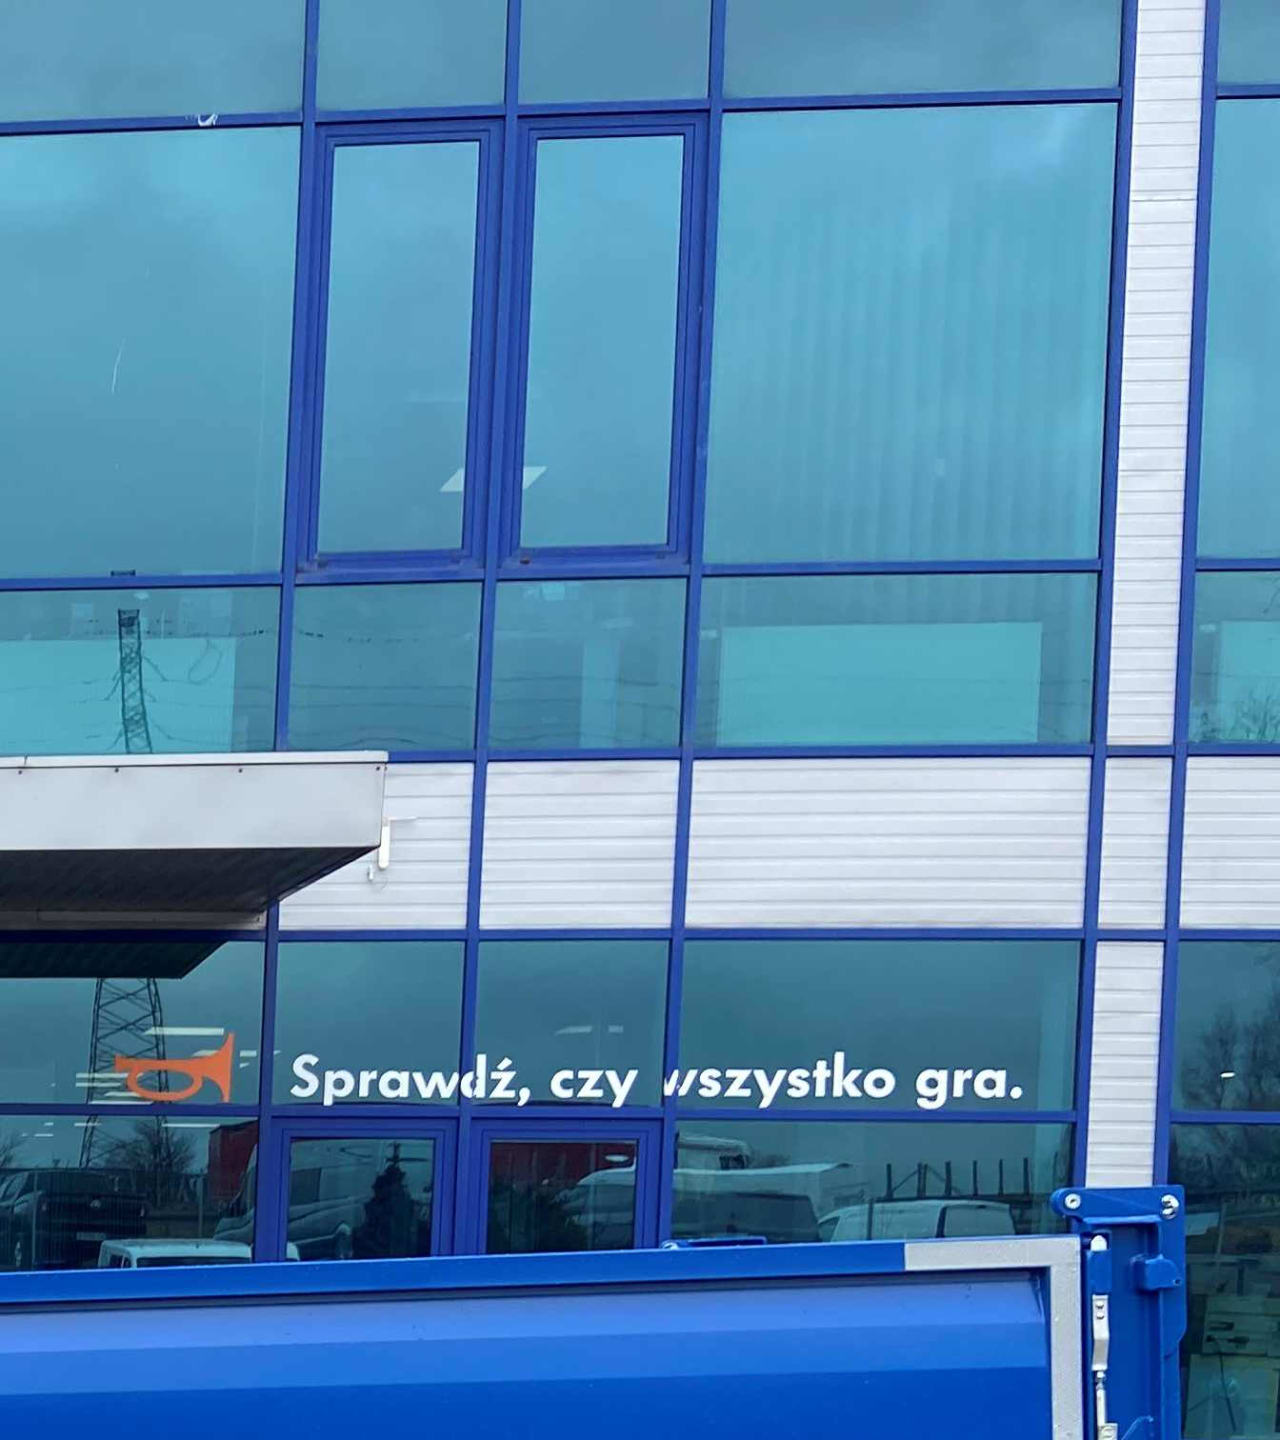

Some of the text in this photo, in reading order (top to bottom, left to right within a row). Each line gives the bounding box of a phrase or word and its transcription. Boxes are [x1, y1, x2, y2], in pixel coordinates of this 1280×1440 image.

[289, 1050, 1023, 1110] Sprawdź, czy wszystko gra.
